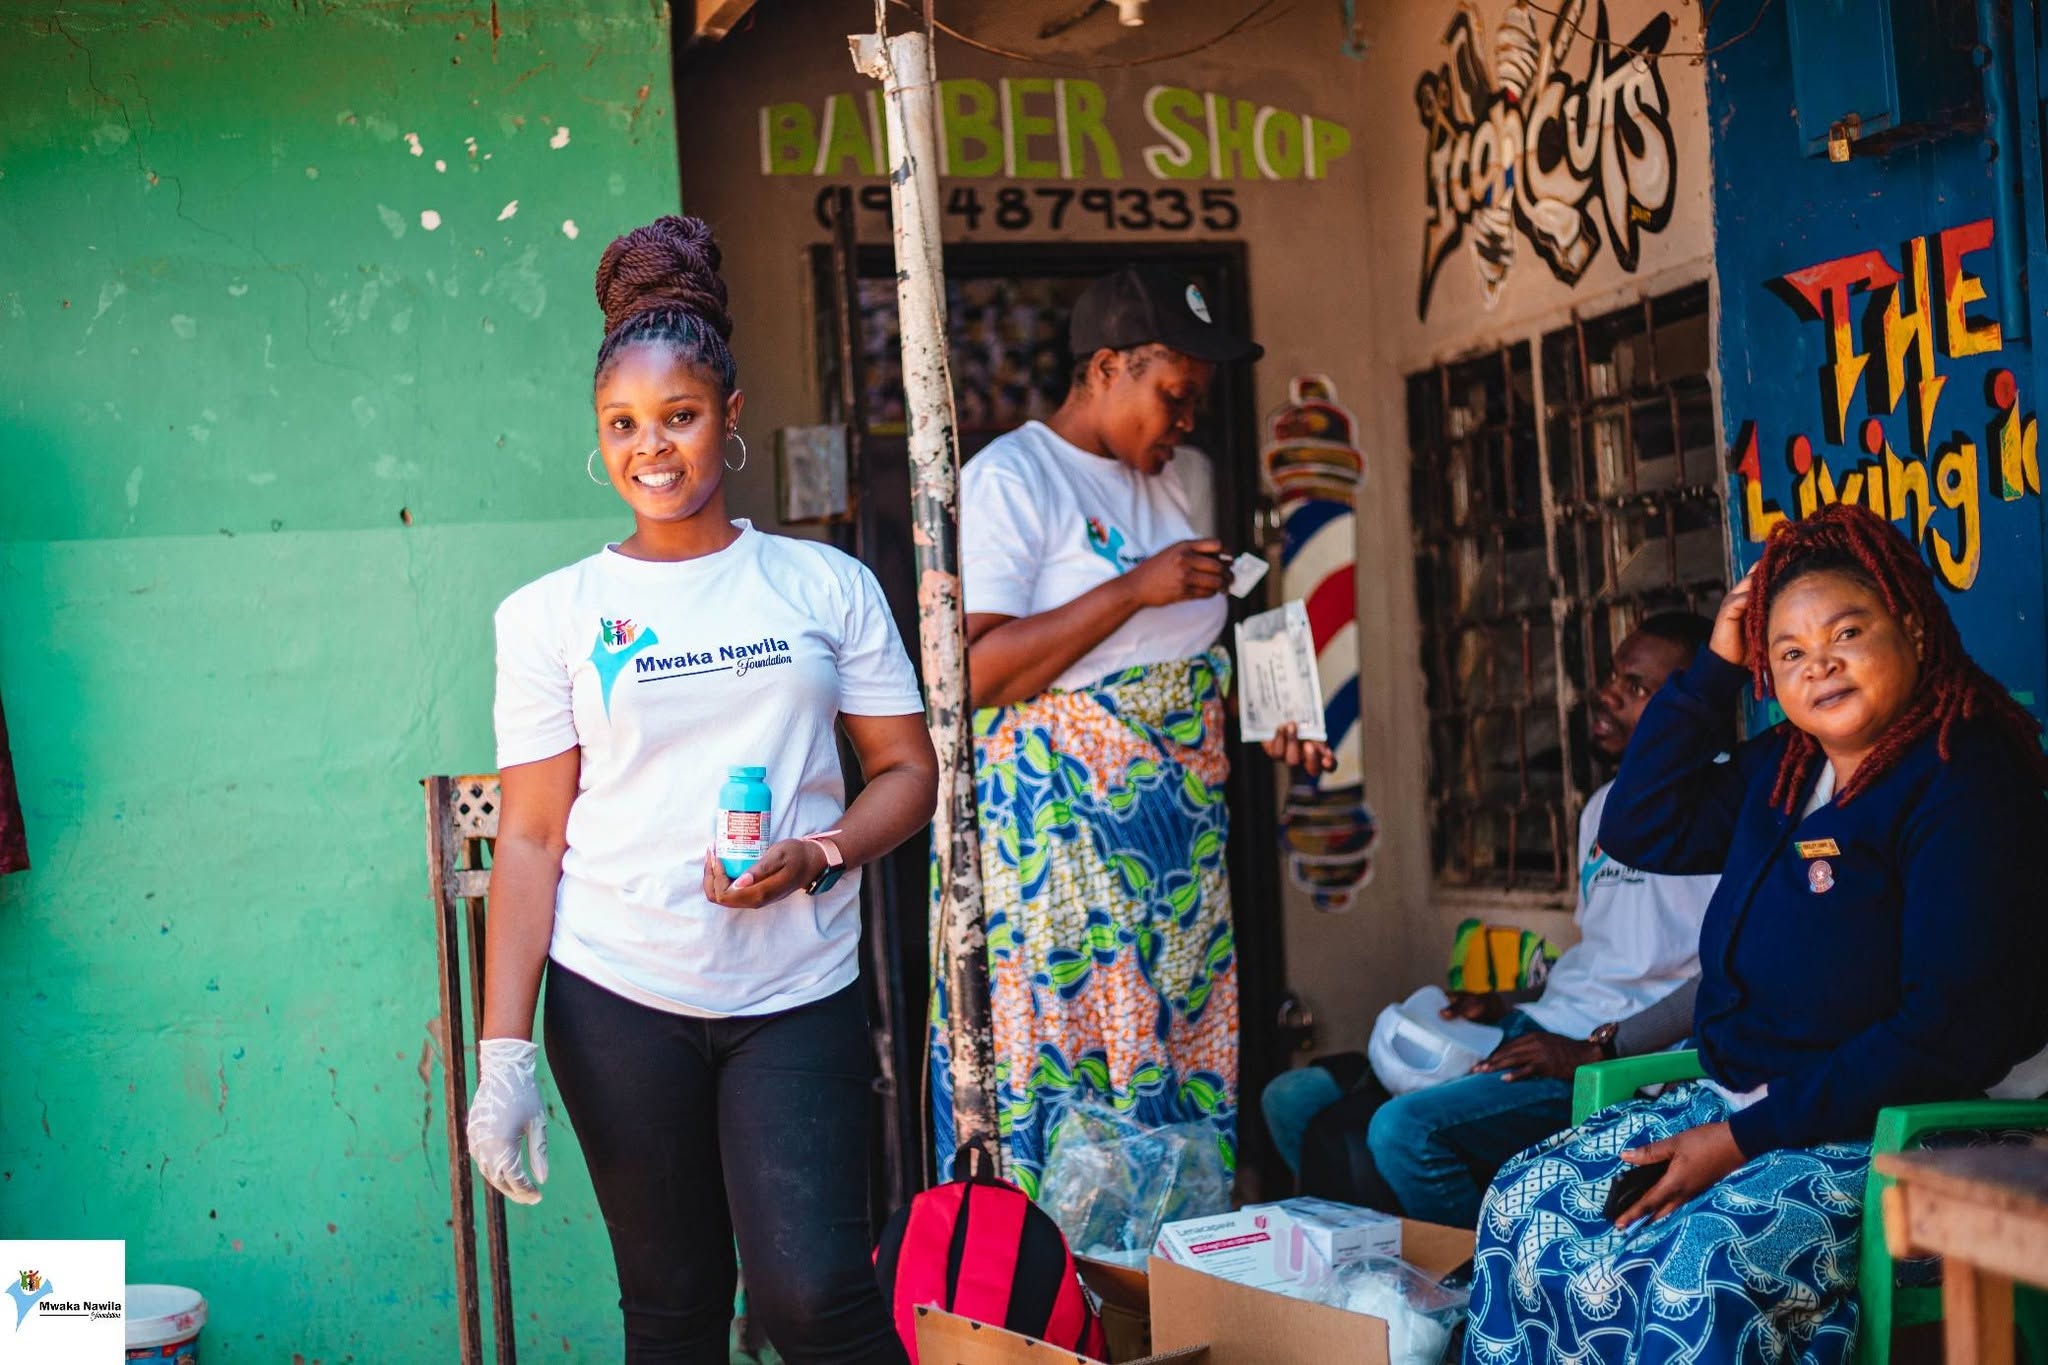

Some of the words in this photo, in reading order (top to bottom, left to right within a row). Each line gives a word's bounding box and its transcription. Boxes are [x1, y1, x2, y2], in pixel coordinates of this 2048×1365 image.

[1142, 85, 1352, 180] SHOP
[814, 186, 1241, 231] 094879335
[1780, 217, 2003, 460] THE
[635, 652, 713, 673] Mwaka
[719, 637, 790, 661] Nawila
[736, 652, 793, 678] Foundation
